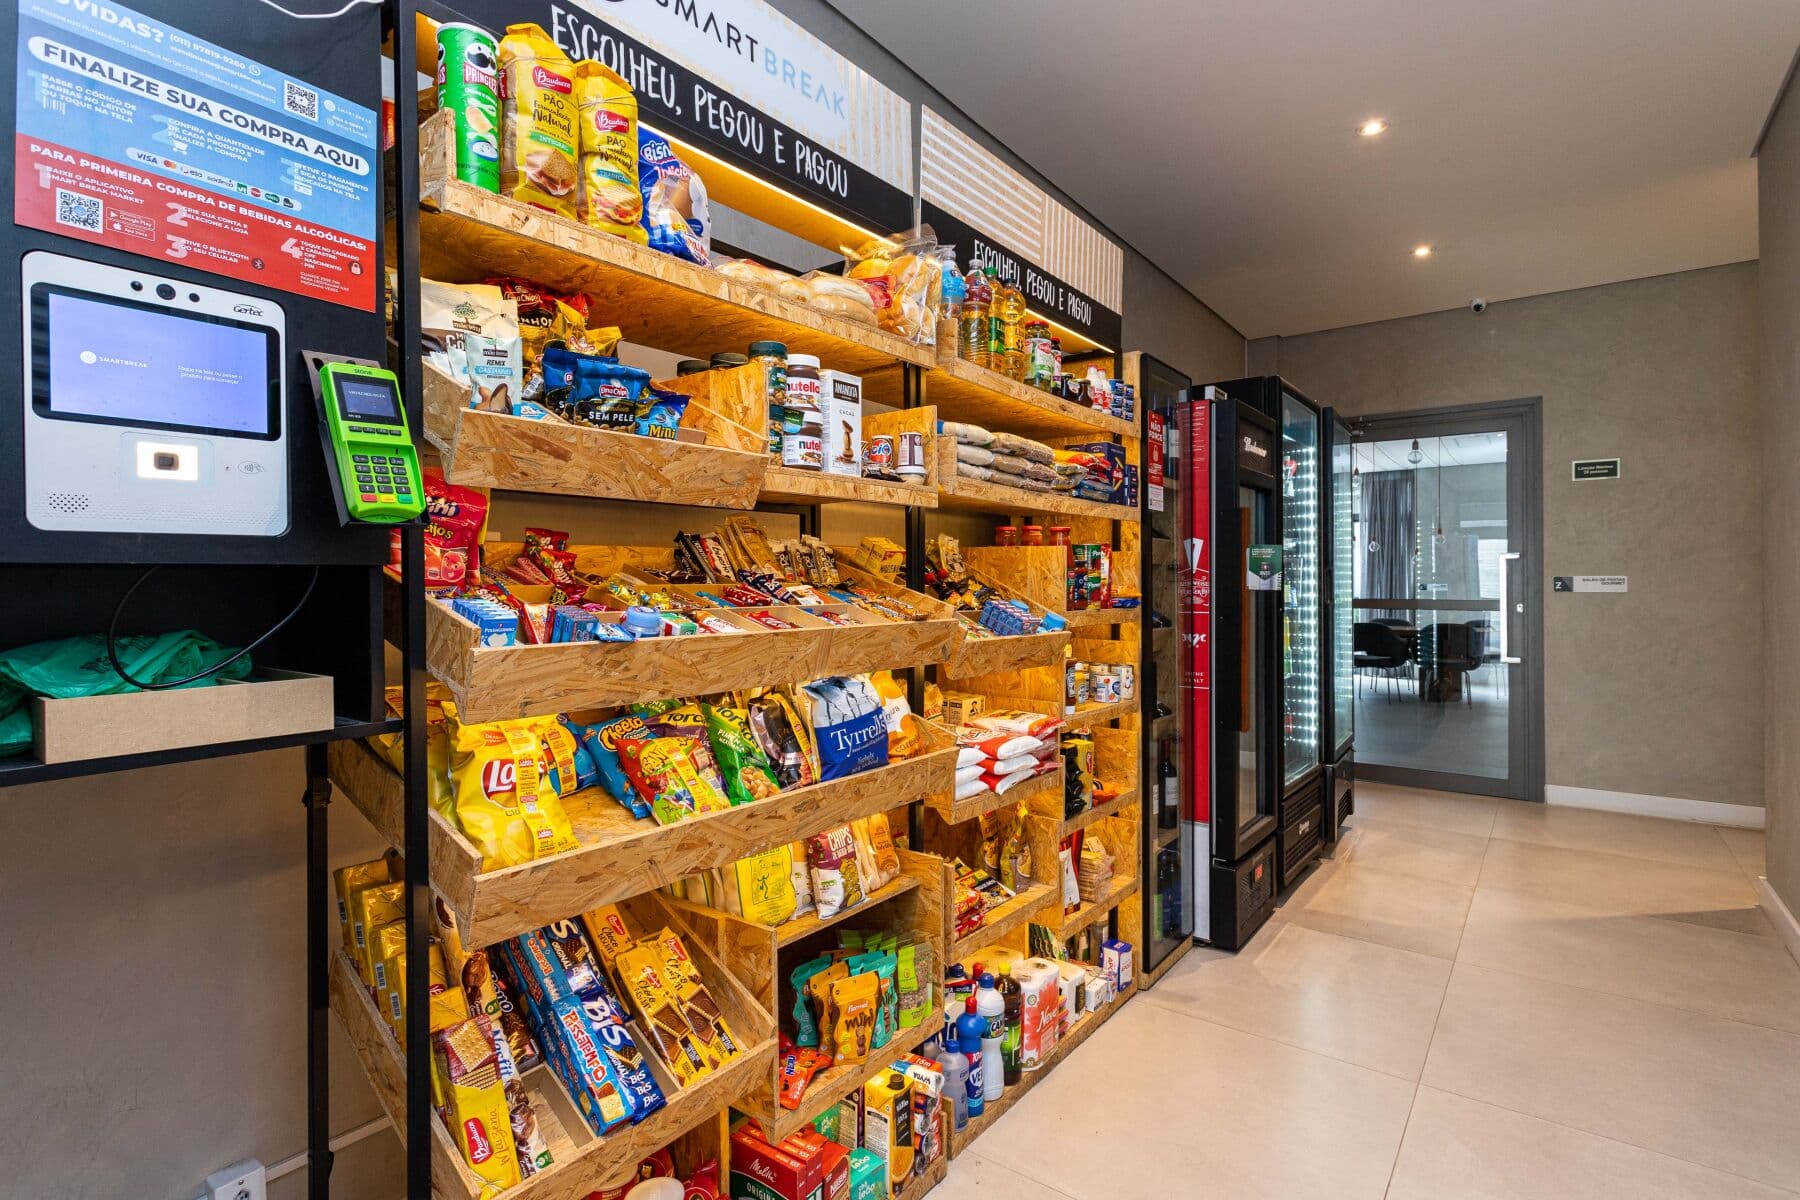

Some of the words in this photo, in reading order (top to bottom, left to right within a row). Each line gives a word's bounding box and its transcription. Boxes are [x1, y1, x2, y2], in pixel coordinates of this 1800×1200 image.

[534, 68, 571, 90] Bauducco
[41, 73, 73, 90] PASSE
[75, 84, 83, 92] O
[85, 86, 123, 106] CÓDIGO
[125, 101, 137, 111] DE
[41, 82, 83, 100] BARRAS
[84, 94, 100, 104] NO
[101, 100, 133, 117] LEITOR
[544, 93, 564, 110] PÃO
[550, 4, 682, 116] ESCOLHEU,
[694, 83, 764, 156] PEGOU
[774, 131, 786, 164] E
[795, 140, 849, 199] PAGOU
[41, 90, 58, 100] OU
[60, 95, 92, 110] TOQUE
[95, 105, 109, 116] NA
[111, 111, 134, 124] TELA
[43, 43, 160, 97] FINALIZE
[166, 89, 213, 117] SUA
[220, 109, 309, 152] COMPRA
[314, 145, 360, 170] AQUI
[533, 109, 573, 137] Natural
[597, 111, 629, 130] Bauducco
[168, 118, 206, 136] CONFIRA
[214, 134, 265, 156] QUANTIDADE
[168, 124, 181, 134] DE
[182, 129, 206, 142] CADA
[207, 137, 246, 156] PRODUTO
[168, 131, 205, 148] FINALIZE
[214, 147, 249, 163] COMPRA
[136, 152, 159, 166] VISA
[30, 143, 76, 165] PARA
[79, 158, 153, 188] PRIMEIRA
[156, 182, 216, 207] COMPRA
[218, 199, 236, 212] DE
[238, 207, 292, 230] BEBIDAS
[46, 173, 77, 186] SMART
[78, 181, 109, 195] BREAK
[110, 190, 145, 205] MARKET
[83, 177, 135, 195] APLICATIVO
[300, 170, 317, 181] SIGA
[318, 176, 327, 184] OS
[328, 179, 354, 193] PASSOS
[328, 173, 369, 192] PAGAMENTO
[333, 188, 344, 196] NA
[344, 192, 361, 201] TELA
[165, 202, 189, 228] 2
[181, 213, 223, 228] SELECIONE
[231, 226, 249, 236] LOJA
[201, 210, 216, 220] SUA
[217, 216, 242, 228] CONTA
[165, 233, 189, 259] 3
[193, 247, 208, 256] SEU
[208, 251, 239, 263] CELULAR
[280, 237, 303, 260] 4
[300, 240, 322, 251] TOQUE
[1026, 268, 1056, 308] PEGOU
[1059, 290, 1065, 311] E
[1068, 292, 1093, 327] PAGOU
[232, 304, 265, 318] Gertec
[588, 412, 609, 421] SEM
[613, 413, 634, 423] PELE
[828, 827, 853, 850] CHIPS
[468, 1120, 492, 1163] Bauducco
[750, 1158, 778, 1183] Melitta
